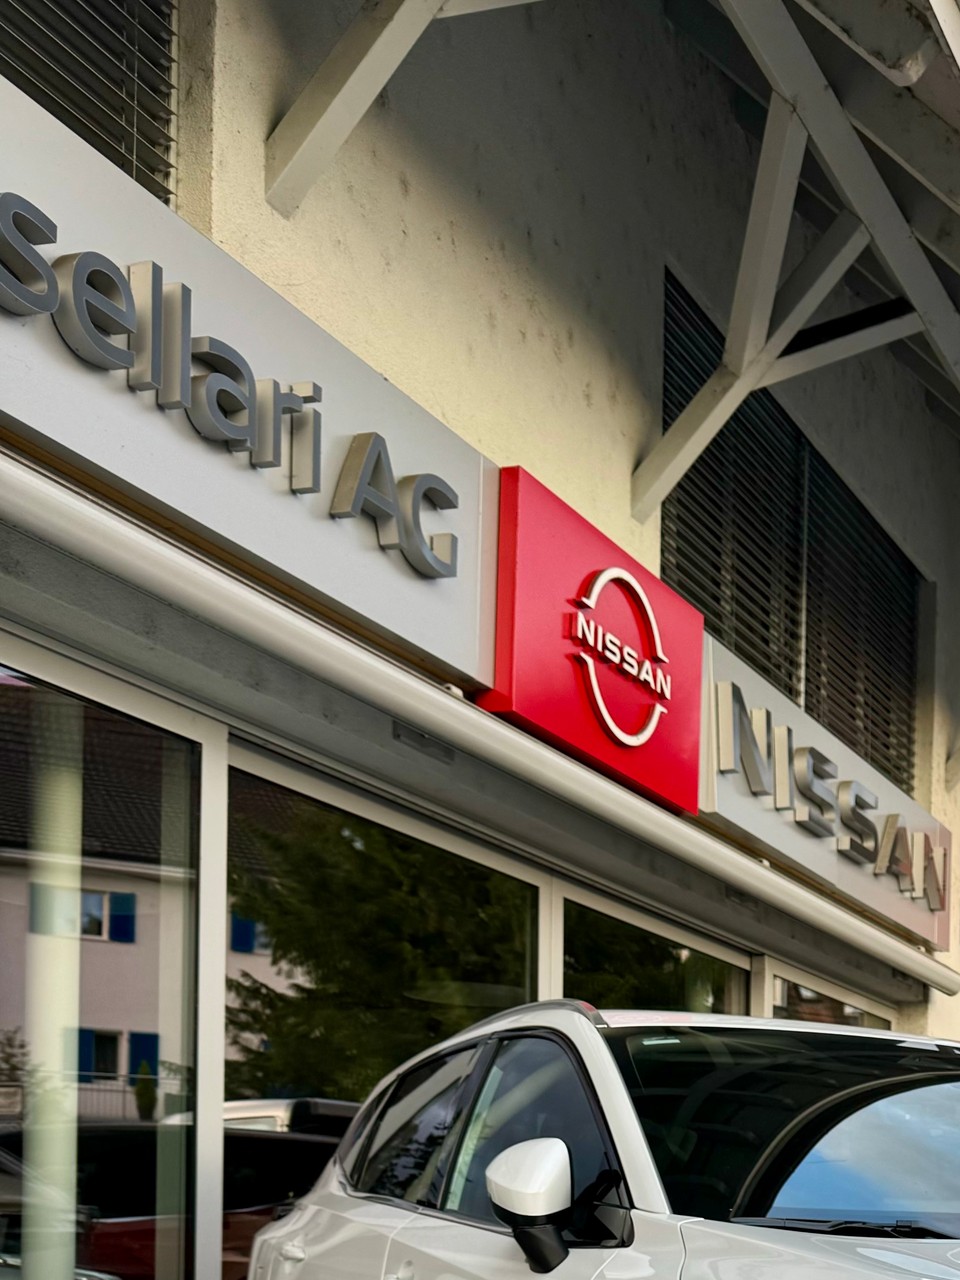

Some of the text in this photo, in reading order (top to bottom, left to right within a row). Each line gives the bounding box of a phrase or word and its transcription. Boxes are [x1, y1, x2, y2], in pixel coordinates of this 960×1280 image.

[330, 432, 459, 579] AG
[577, 611, 671, 700] NISSAN
[717, 681, 947, 911] NISSAN
